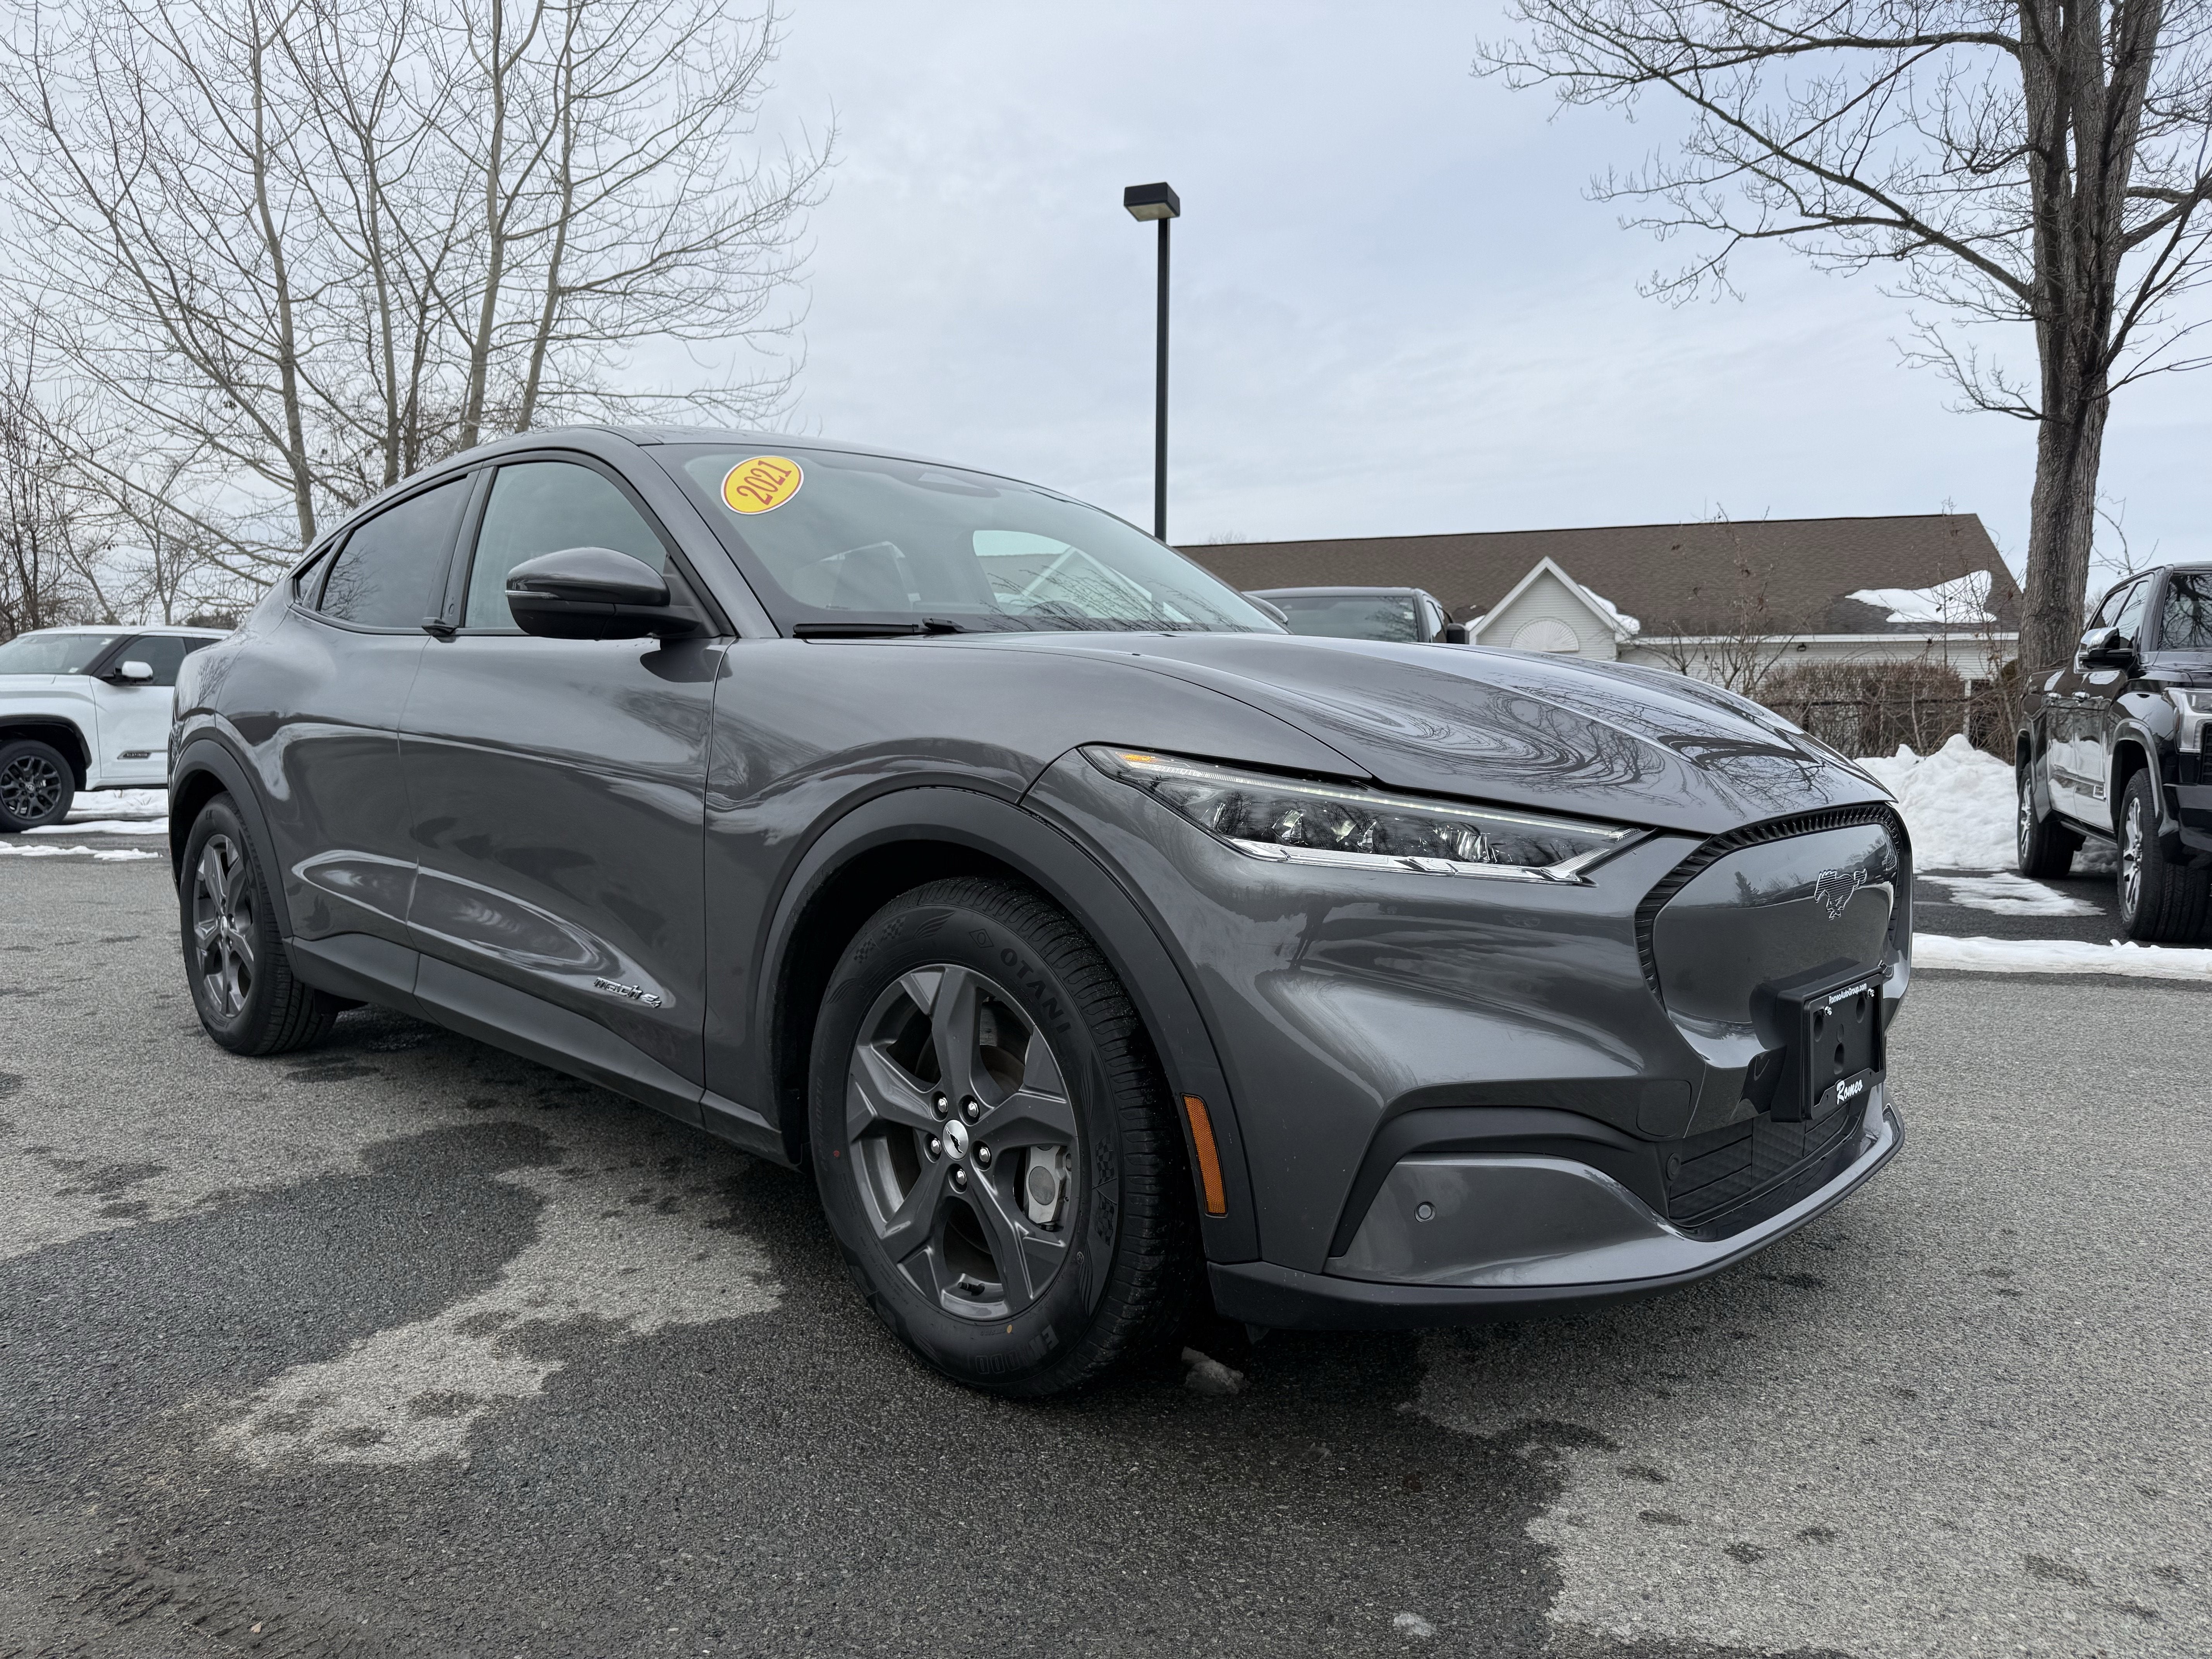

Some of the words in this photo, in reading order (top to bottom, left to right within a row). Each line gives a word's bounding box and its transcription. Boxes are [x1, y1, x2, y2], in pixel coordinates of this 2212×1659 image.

[737, 460, 792, 505] 2021
[1000, 948, 1071, 1033] OTANI
[1829, 983, 1867, 1005] RomeoAutoGroup.com
[1836, 1079, 1863, 1105] Romeo
